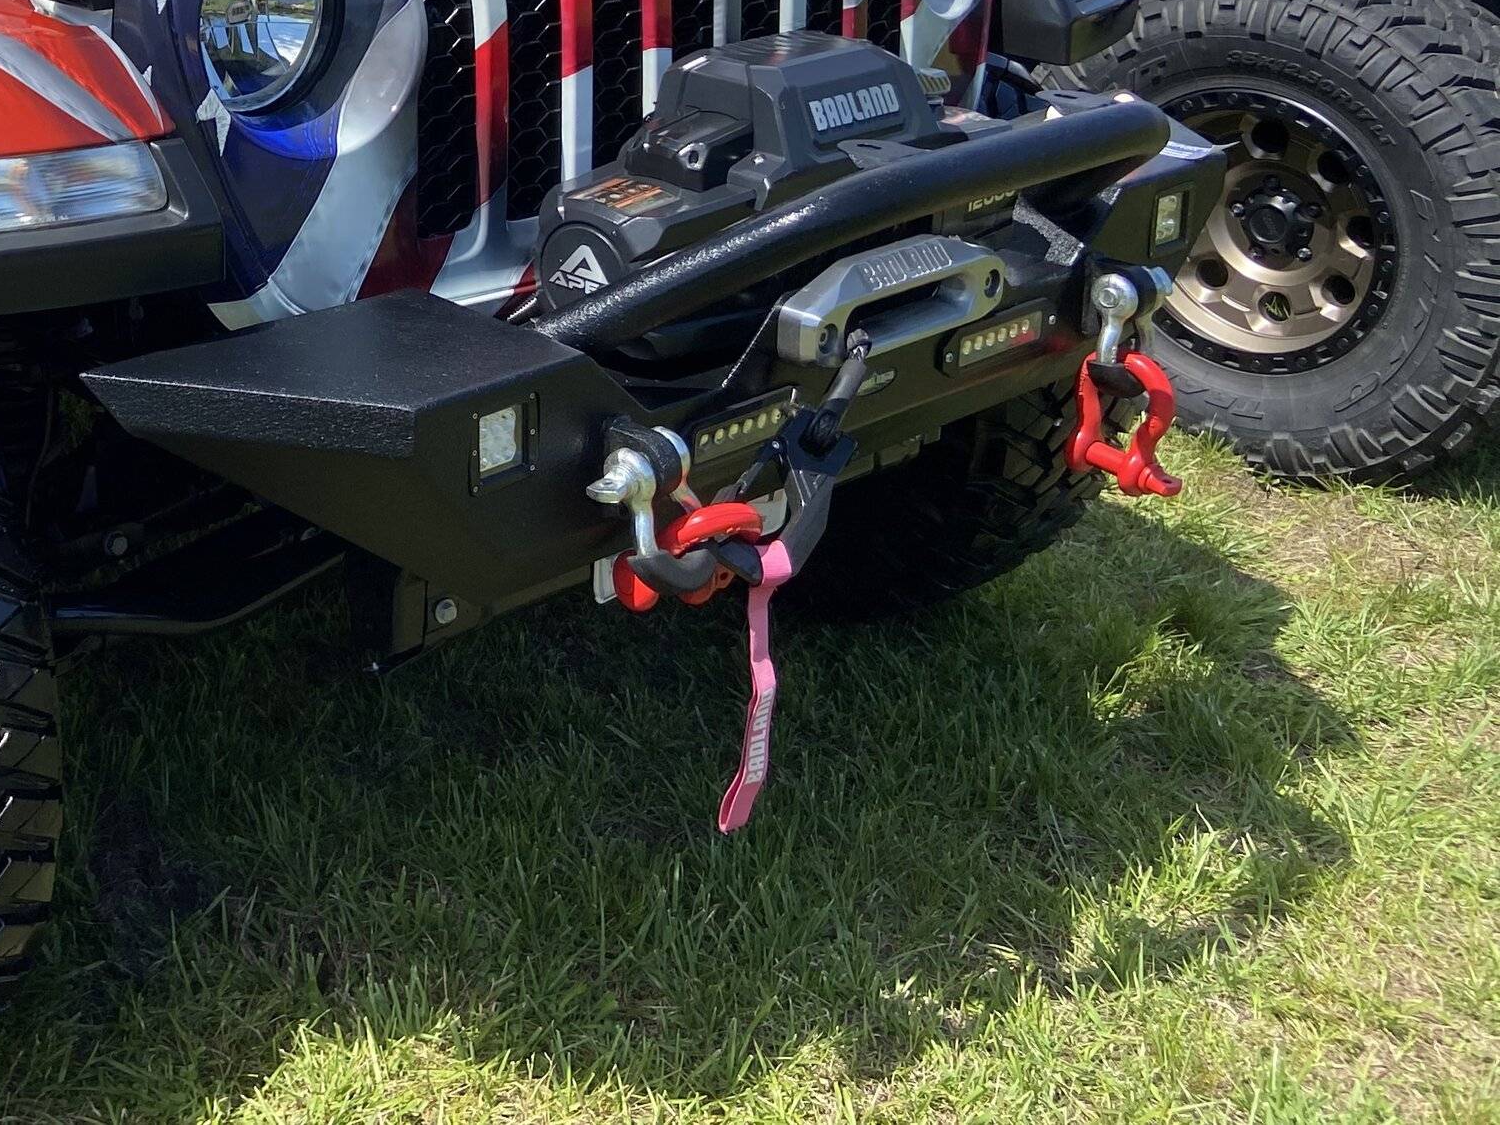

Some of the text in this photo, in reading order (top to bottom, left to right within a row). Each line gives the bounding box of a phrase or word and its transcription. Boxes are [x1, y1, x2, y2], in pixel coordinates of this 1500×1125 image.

[809, 82, 899, 131] BADLAND
[548, 271, 601, 294] APE
[862, 239, 952, 291] BADLAND
[747, 687, 774, 784] BADLAND
